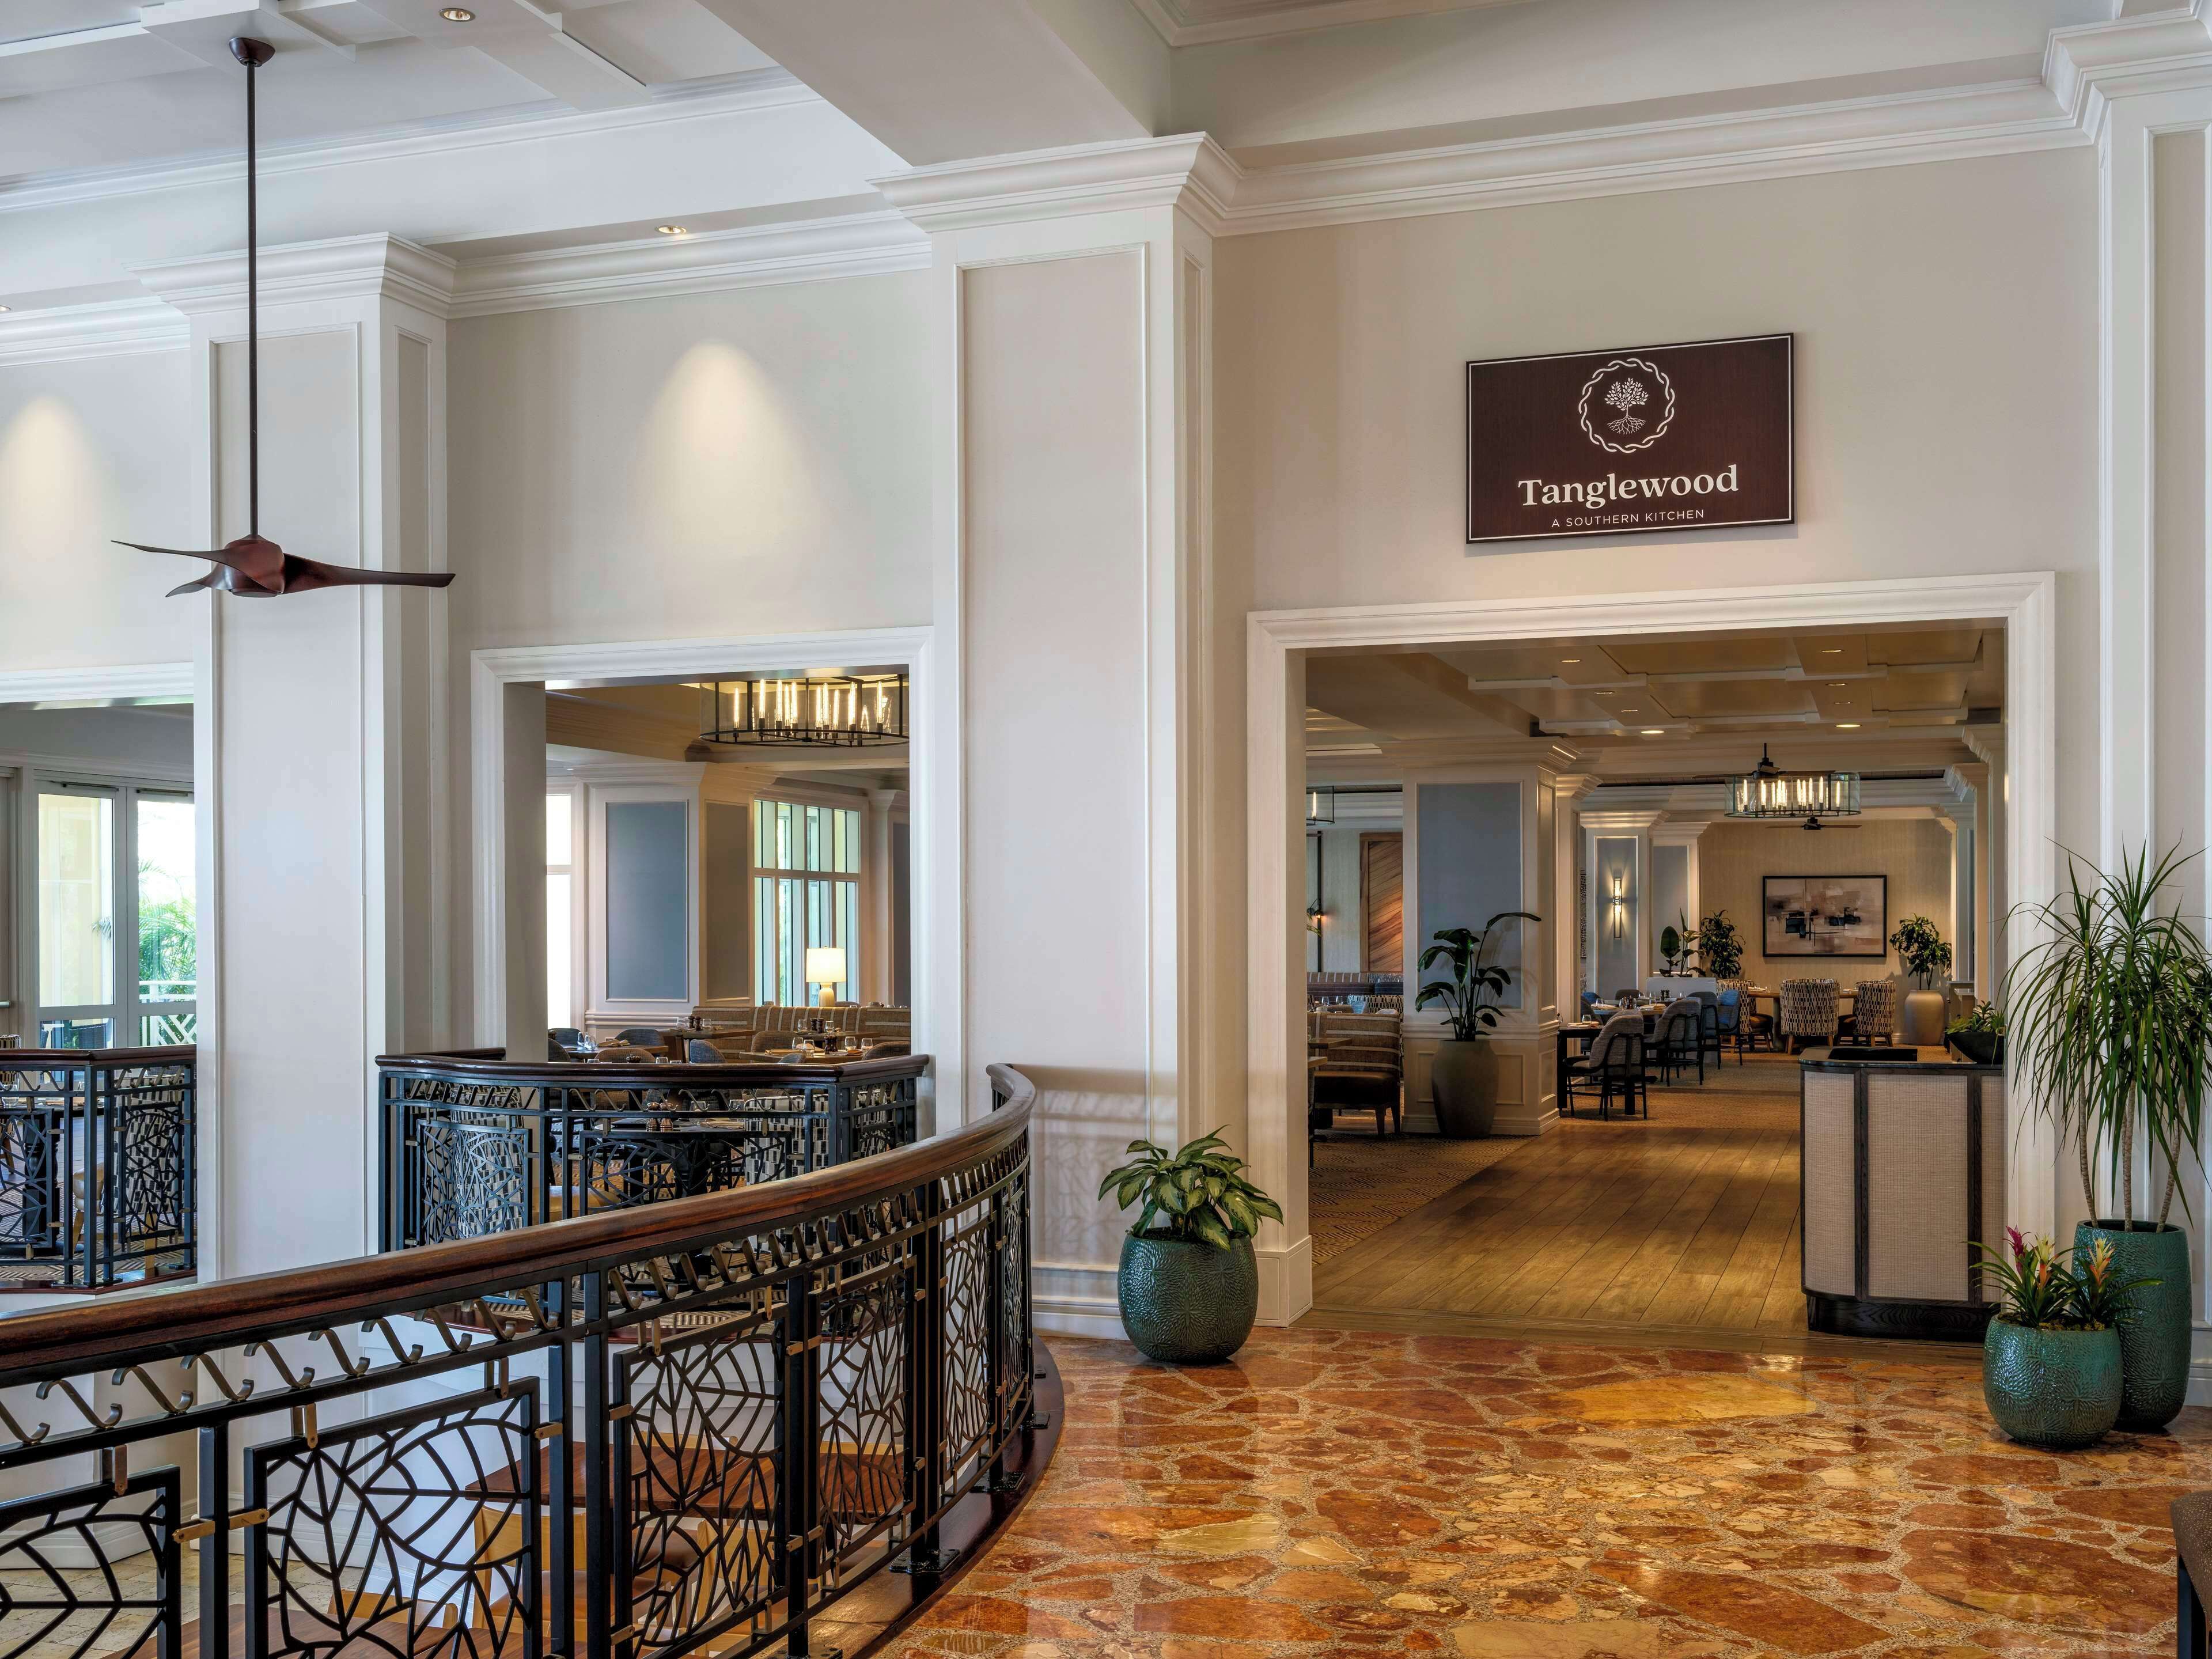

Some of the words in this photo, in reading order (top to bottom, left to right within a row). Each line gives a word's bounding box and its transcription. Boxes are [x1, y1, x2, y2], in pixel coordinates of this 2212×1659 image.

[1518, 464, 1739, 509] Tanglewood
[1551, 518, 1560, 528] A
[1566, 514, 1639, 527] SOUTHERN
[1645, 509, 1705, 522] KITCHEN
